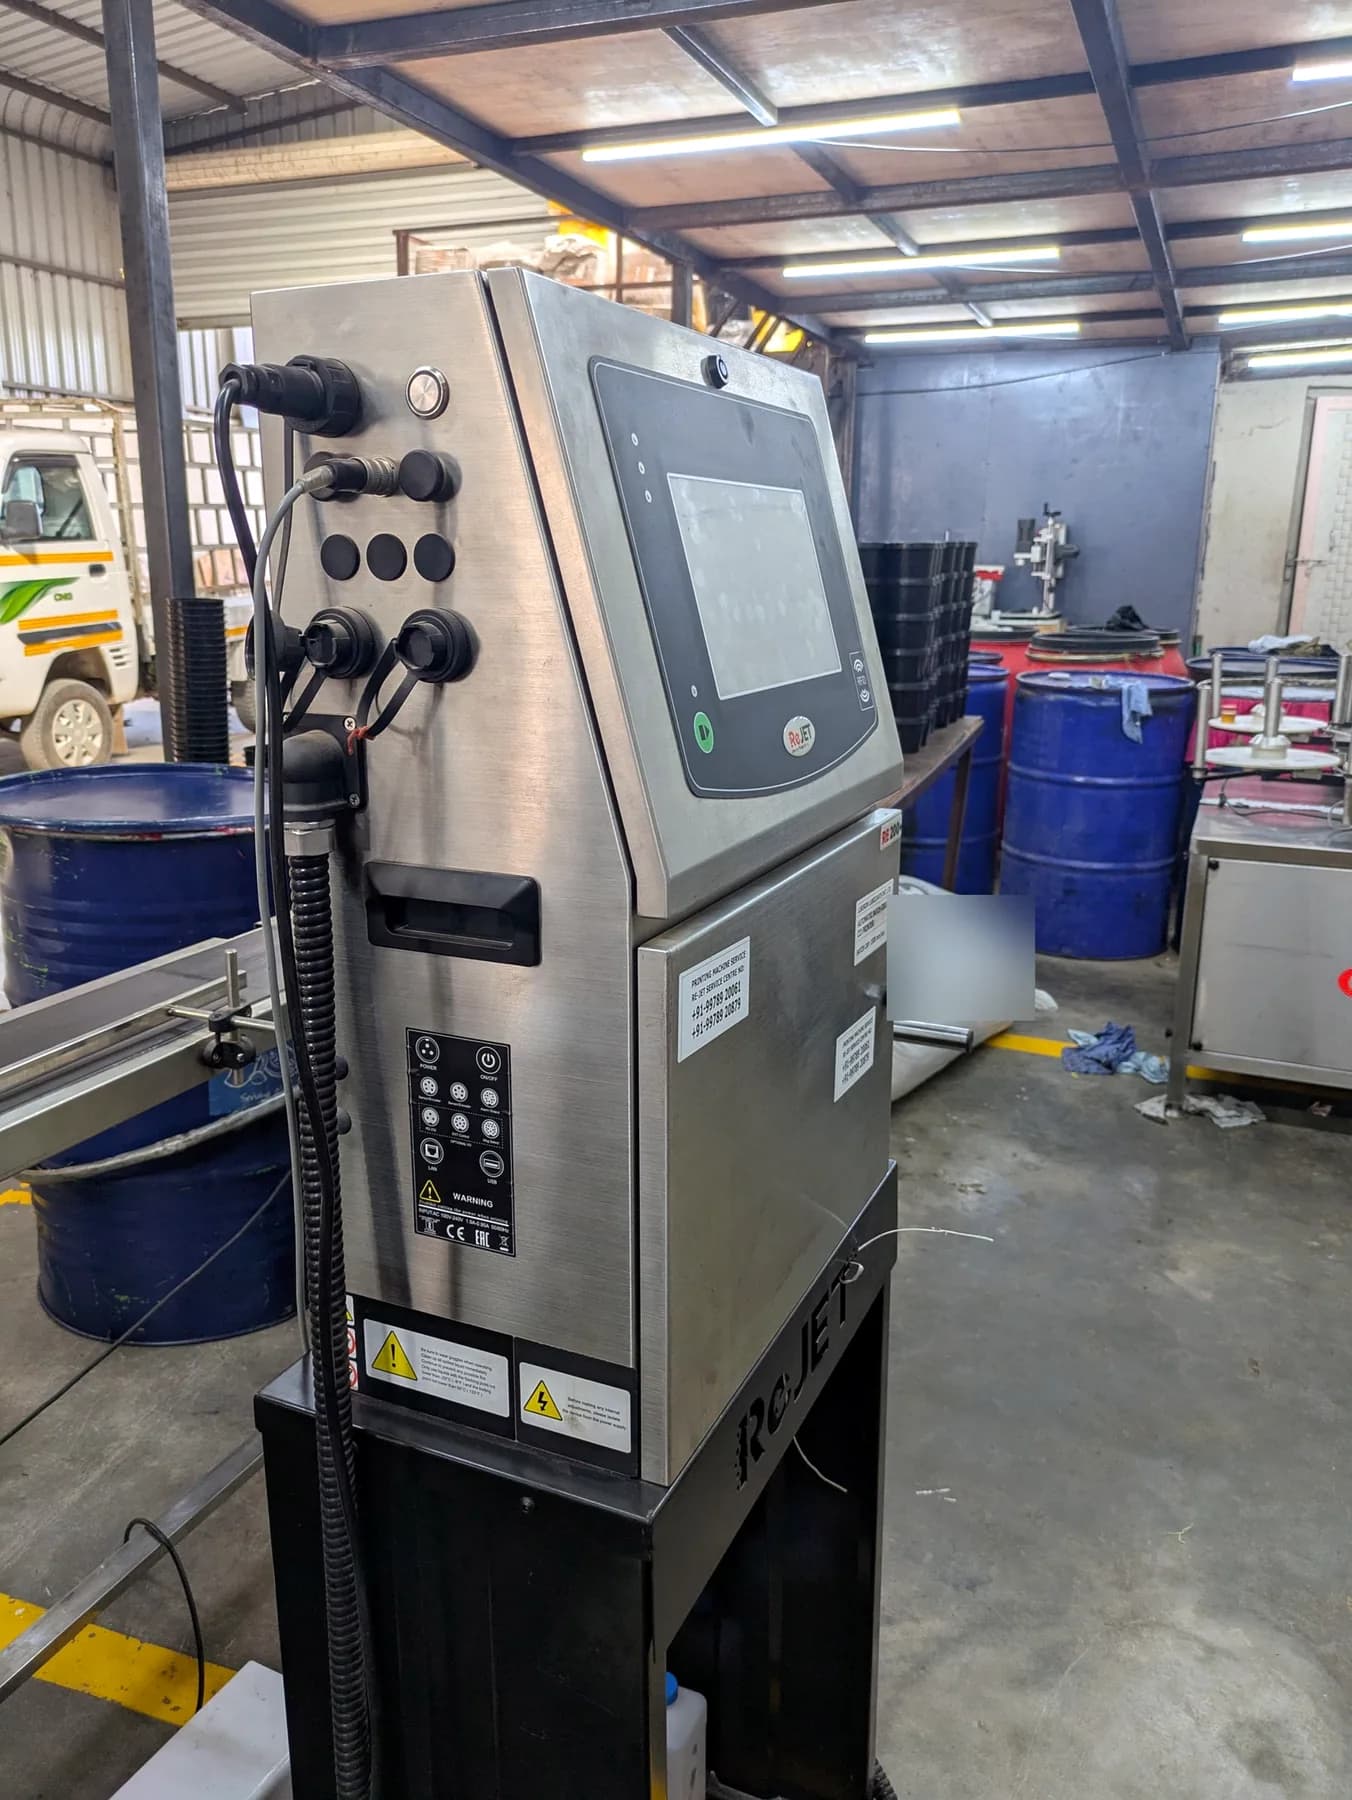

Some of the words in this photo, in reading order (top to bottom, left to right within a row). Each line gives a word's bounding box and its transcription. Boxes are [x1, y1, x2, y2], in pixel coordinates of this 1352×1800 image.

[691, 970, 712, 988] PRINTING
[712, 959, 730, 977] MACHINE
[730, 950, 746, 966] SERVICE
[691, 987, 706, 1002] RE-JET
[706, 978, 722, 994] SERVICE
[723, 968, 738, 984] CENTRE
[691, 990, 723, 1021] +91-99789
[724, 980, 741, 1001] 20061
[691, 1008, 723, 1039] +91-99789
[452, 1192, 493, 1208] WARNING
